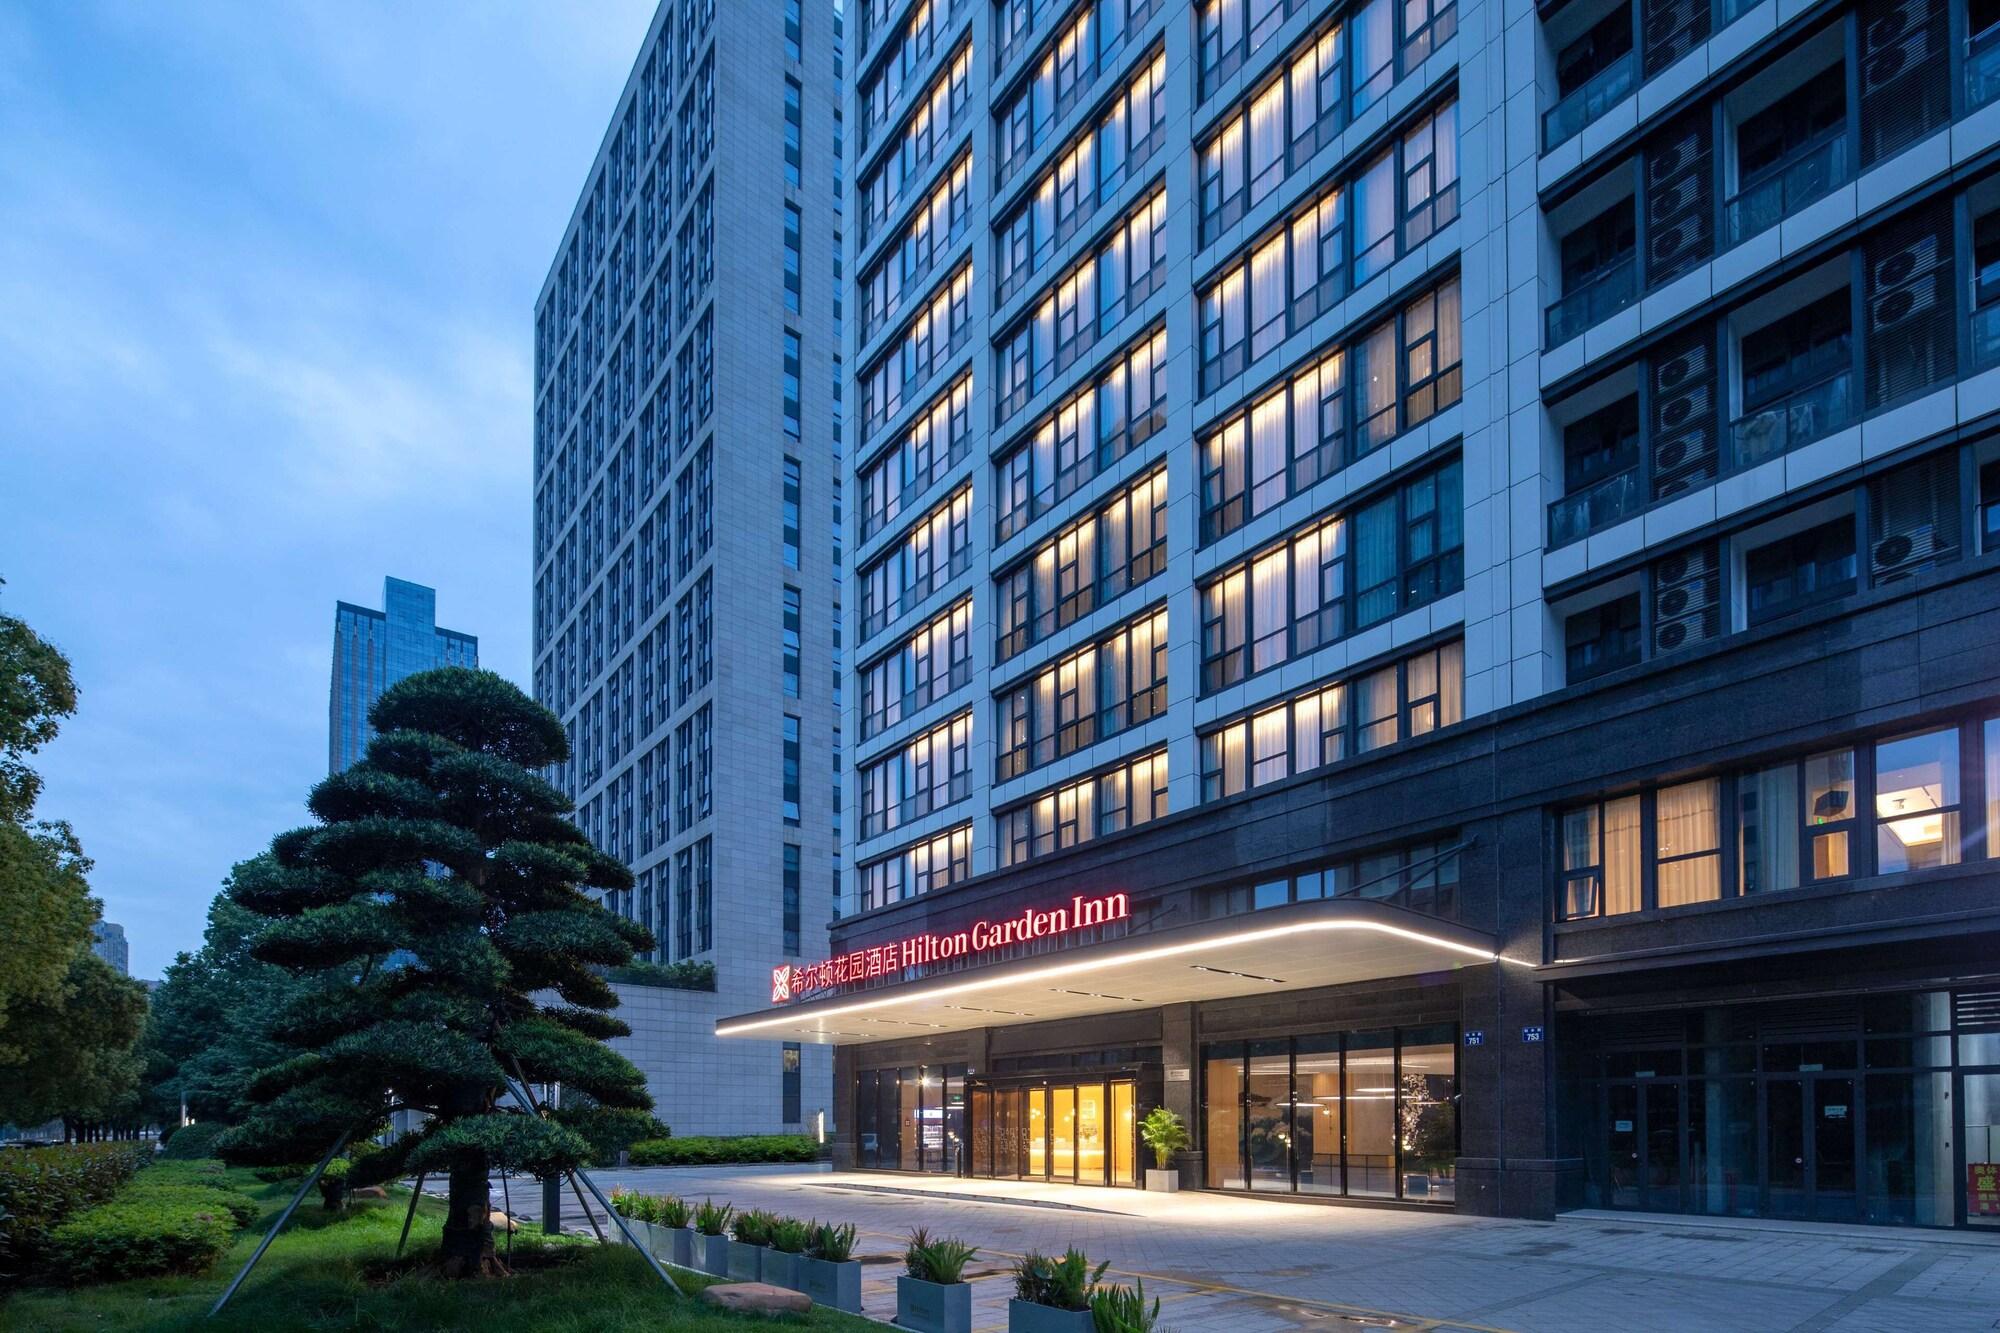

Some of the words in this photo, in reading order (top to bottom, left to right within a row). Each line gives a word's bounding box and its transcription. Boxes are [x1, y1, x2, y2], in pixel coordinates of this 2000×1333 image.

[792, 942, 898, 994] 希尔顿花园酒店
[902, 932, 968, 967] Hilton
[972, 908, 1068, 951] Garden
[1072, 893, 1128, 928] Inn
[1468, 1037, 1480, 1045] 751
[1527, 1033, 1540, 1041] 753
